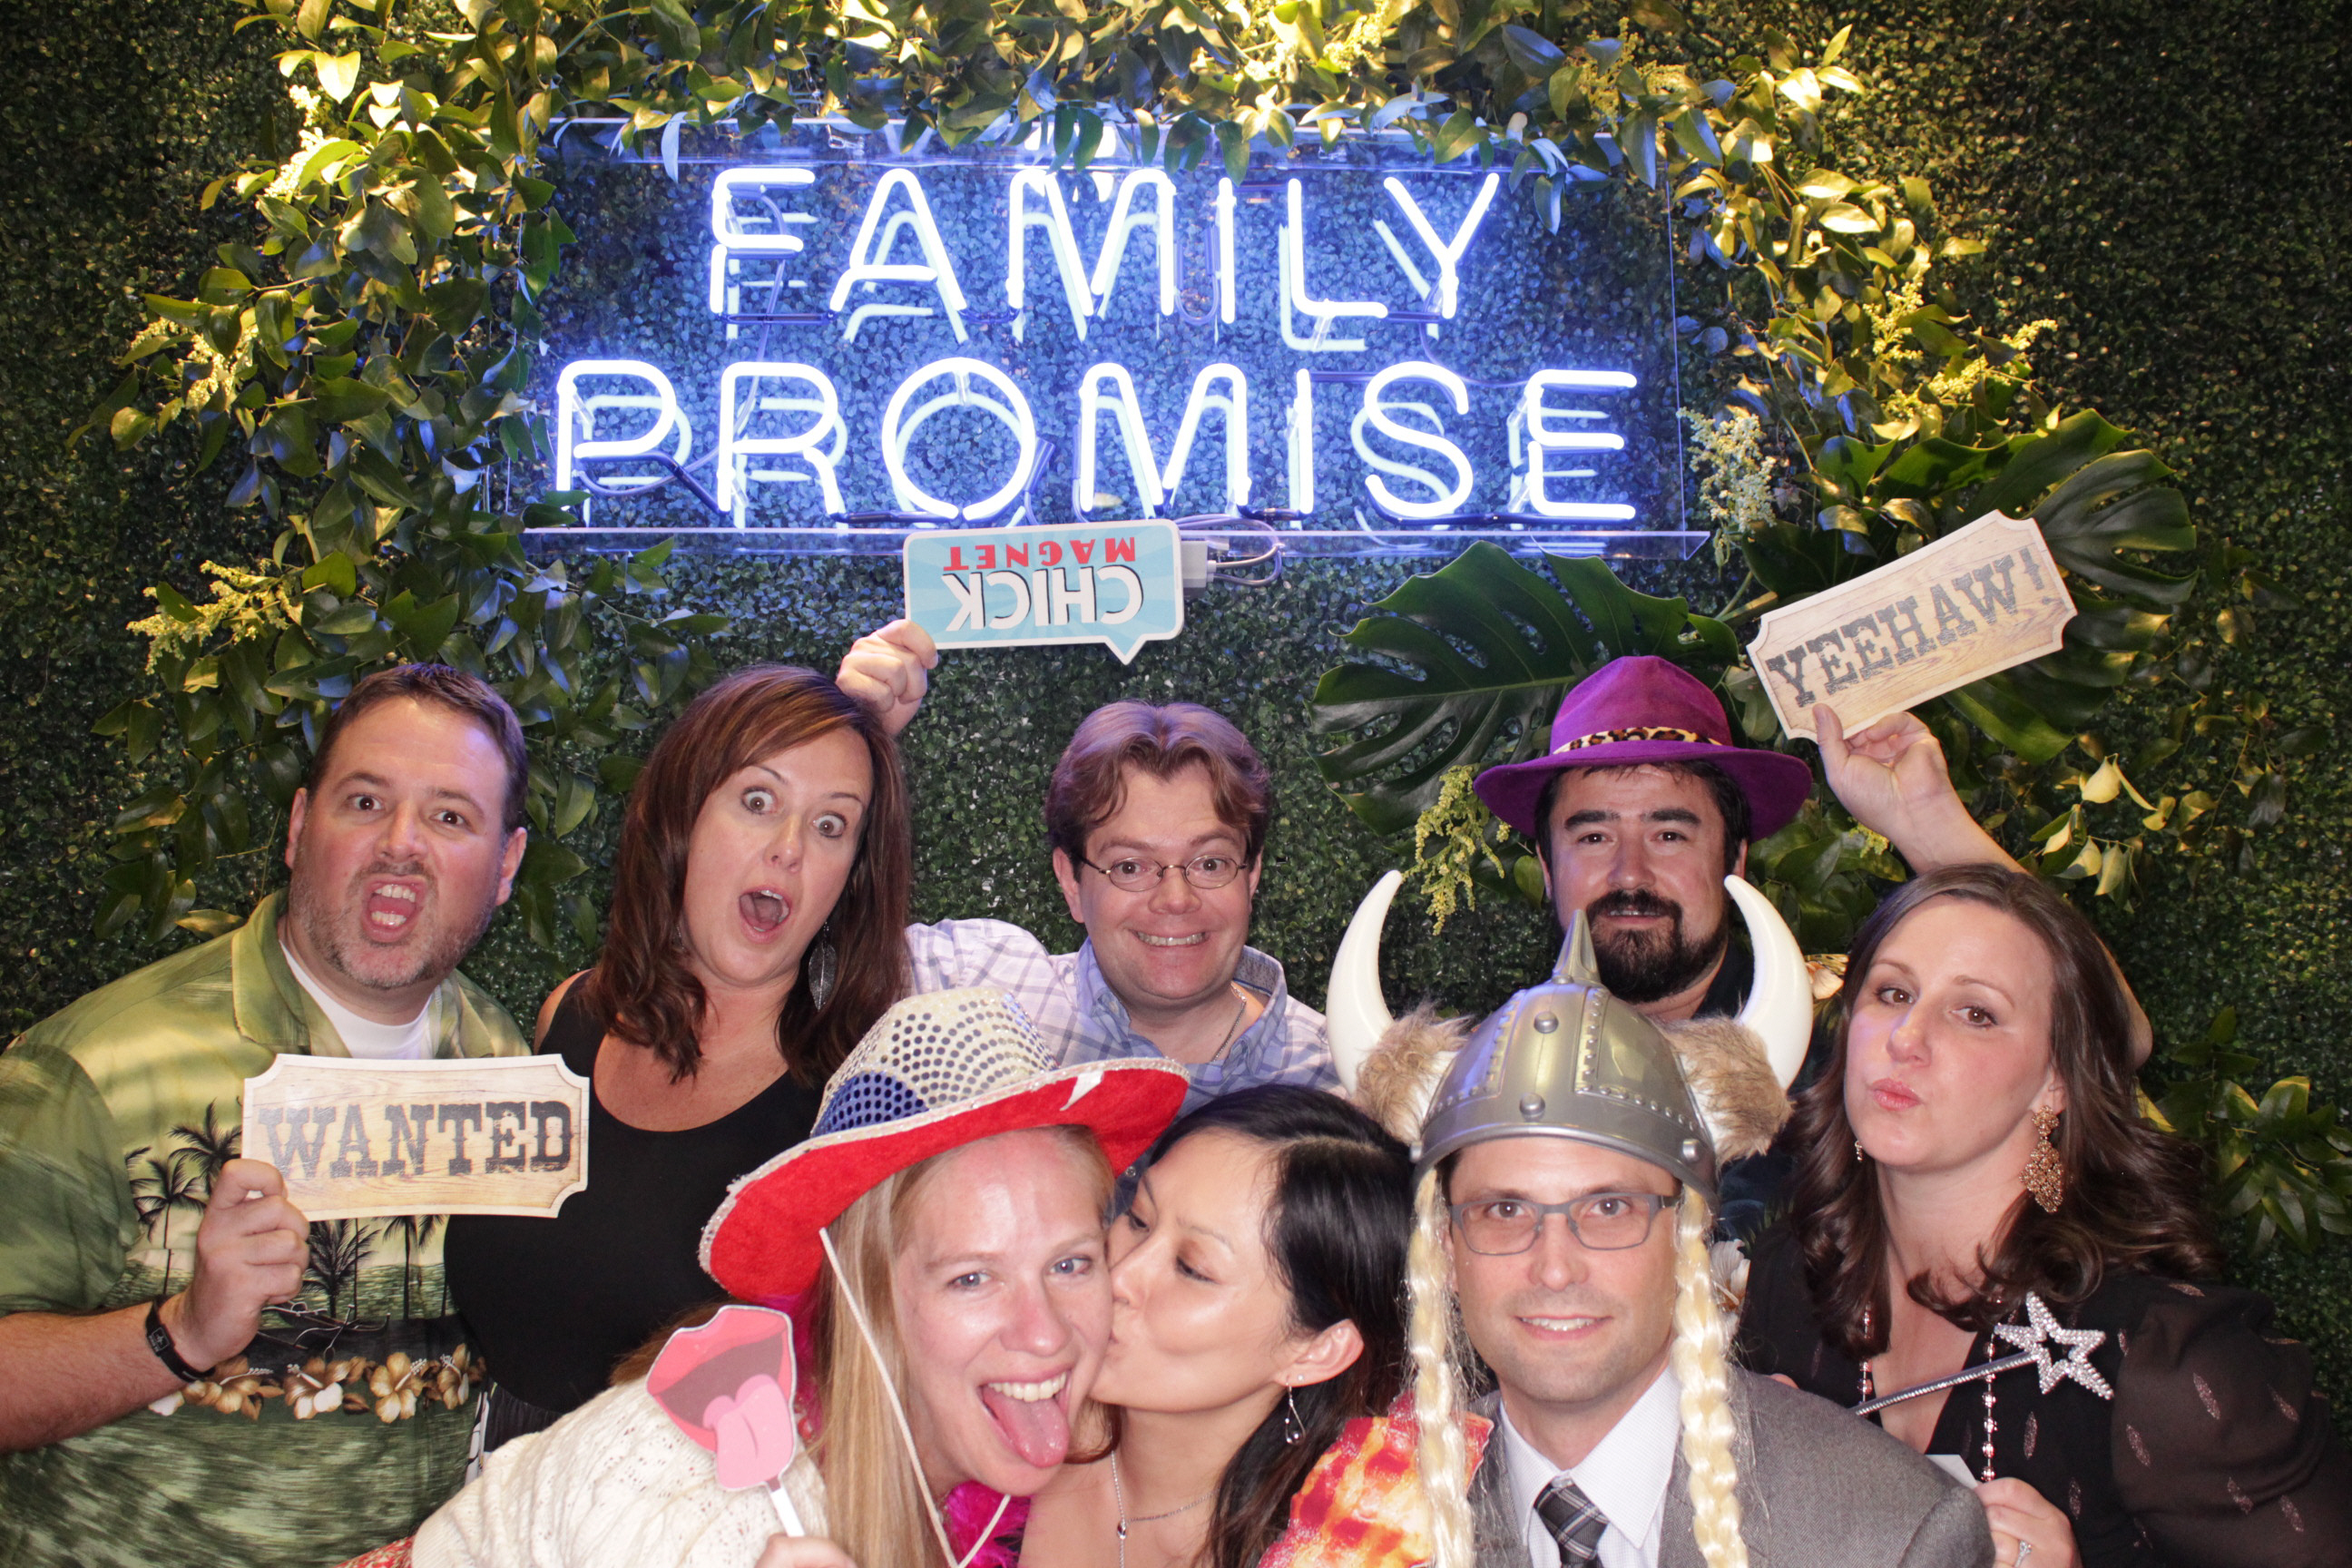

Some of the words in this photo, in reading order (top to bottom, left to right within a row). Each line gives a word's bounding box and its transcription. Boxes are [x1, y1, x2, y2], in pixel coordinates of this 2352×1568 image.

[709, 168, 1499, 323] FAMILY
[556, 358, 1637, 520] PROMISE
[941, 564, 1143, 632] CHICK
[943, 536, 1136, 571] MAGNET
[1766, 548, 2044, 708] YEEHAW!
[258, 1101, 573, 1180] WANTED
